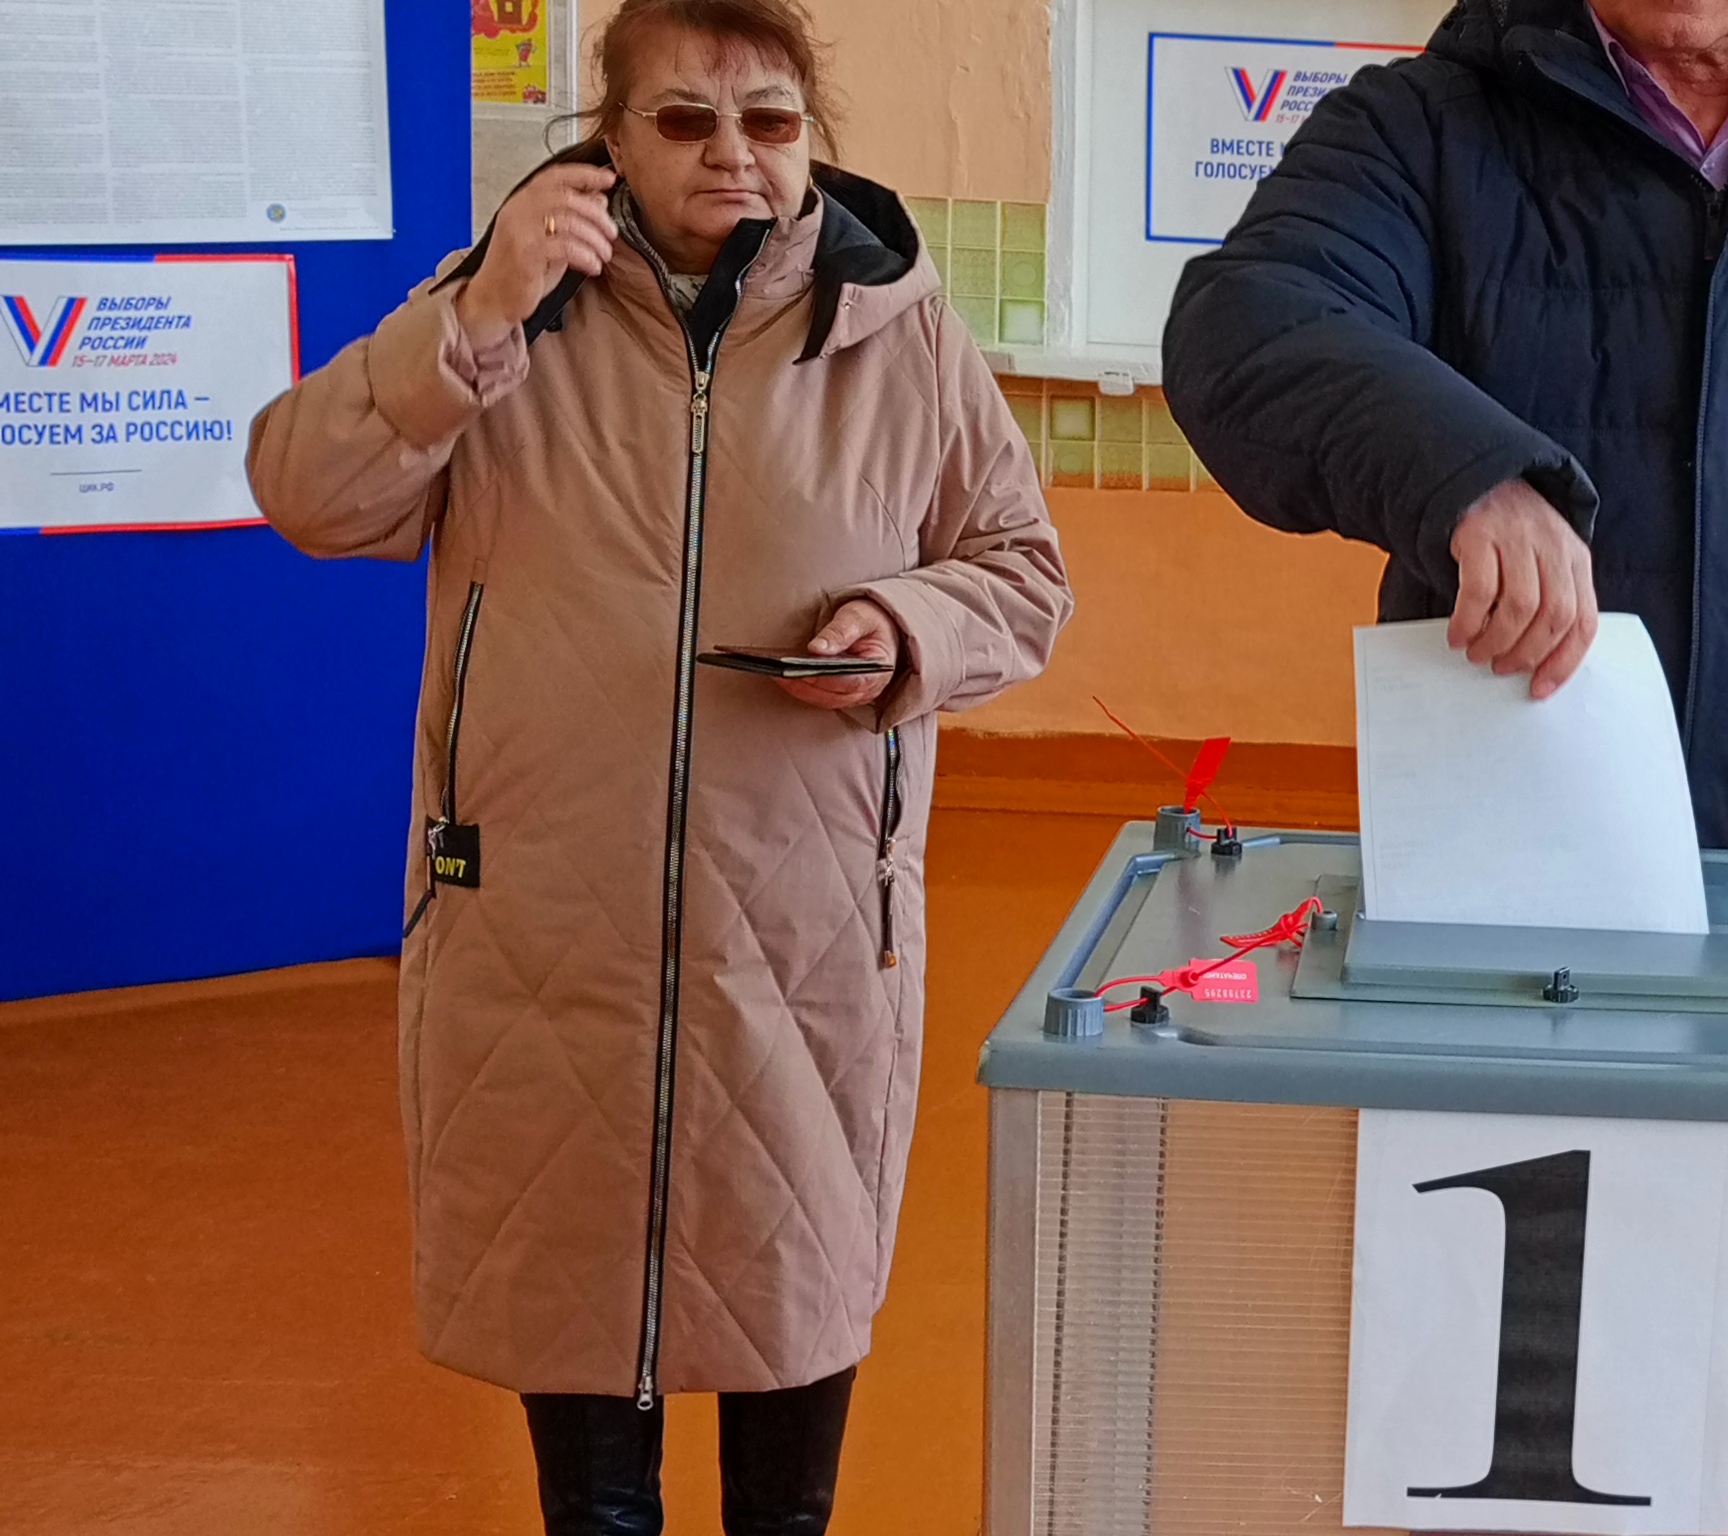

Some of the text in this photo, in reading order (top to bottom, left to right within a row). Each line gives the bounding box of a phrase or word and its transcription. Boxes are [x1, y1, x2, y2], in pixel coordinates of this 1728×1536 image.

[1293, 70, 1348, 84] ВЫБОРЫ
[1287, 85, 1327, 97] ПРЕЗИ
[1280, 100, 1313, 112] РОСС
[1210, 137, 1275, 157] ВМЕСТЕ
[96, 296, 172, 312] ВЫБОРЫ
[87, 315, 192, 332] ПРЕЗИДЕНТА
[78, 335, 148, 351] РОССИИ
[107, 354, 148, 367] МАРТА
[149, 352, 178, 367] 2024
[79, 392, 121, 413] МЫ
[127, 389, 188, 412] СИЛА
[91, 423, 119, 444] ЗА
[125, 419, 233, 443] РОССИЮ!
[1406, 1149, 1651, 1506] 1
